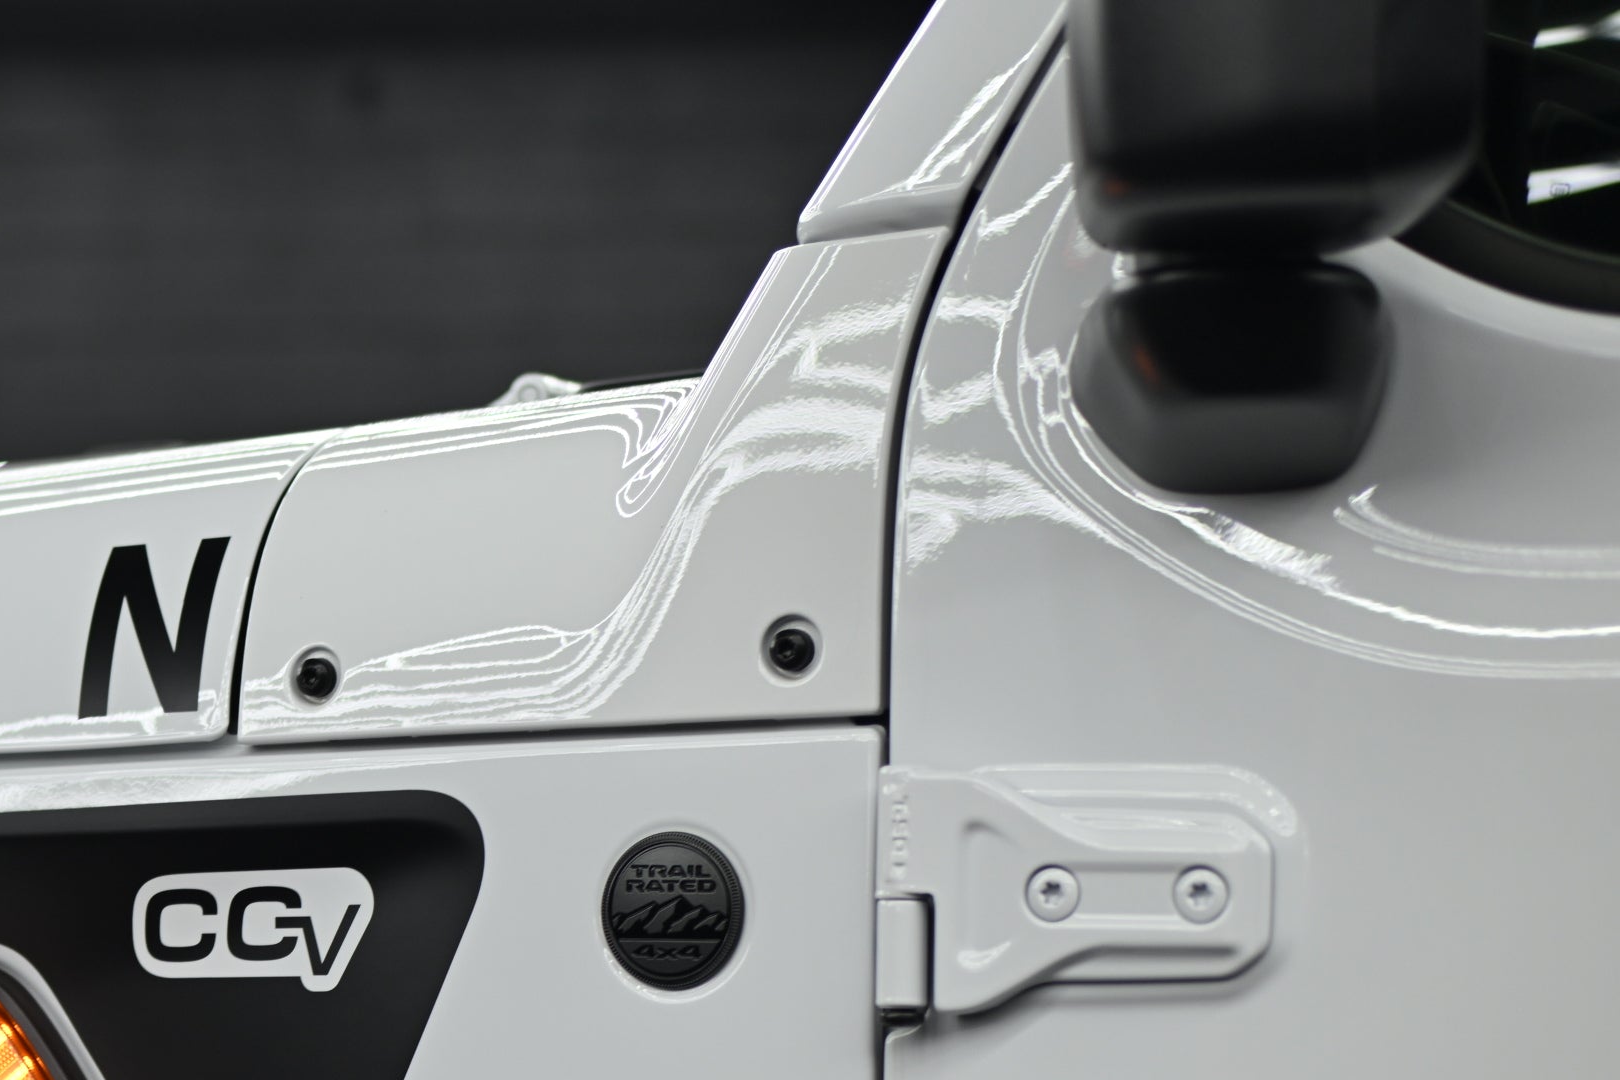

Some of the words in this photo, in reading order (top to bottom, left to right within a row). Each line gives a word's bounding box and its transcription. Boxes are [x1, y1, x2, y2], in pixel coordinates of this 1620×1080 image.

[630, 864, 712, 878] TRAIL
[625, 878, 717, 893] RATED
[144, 885, 362, 976] CGV
